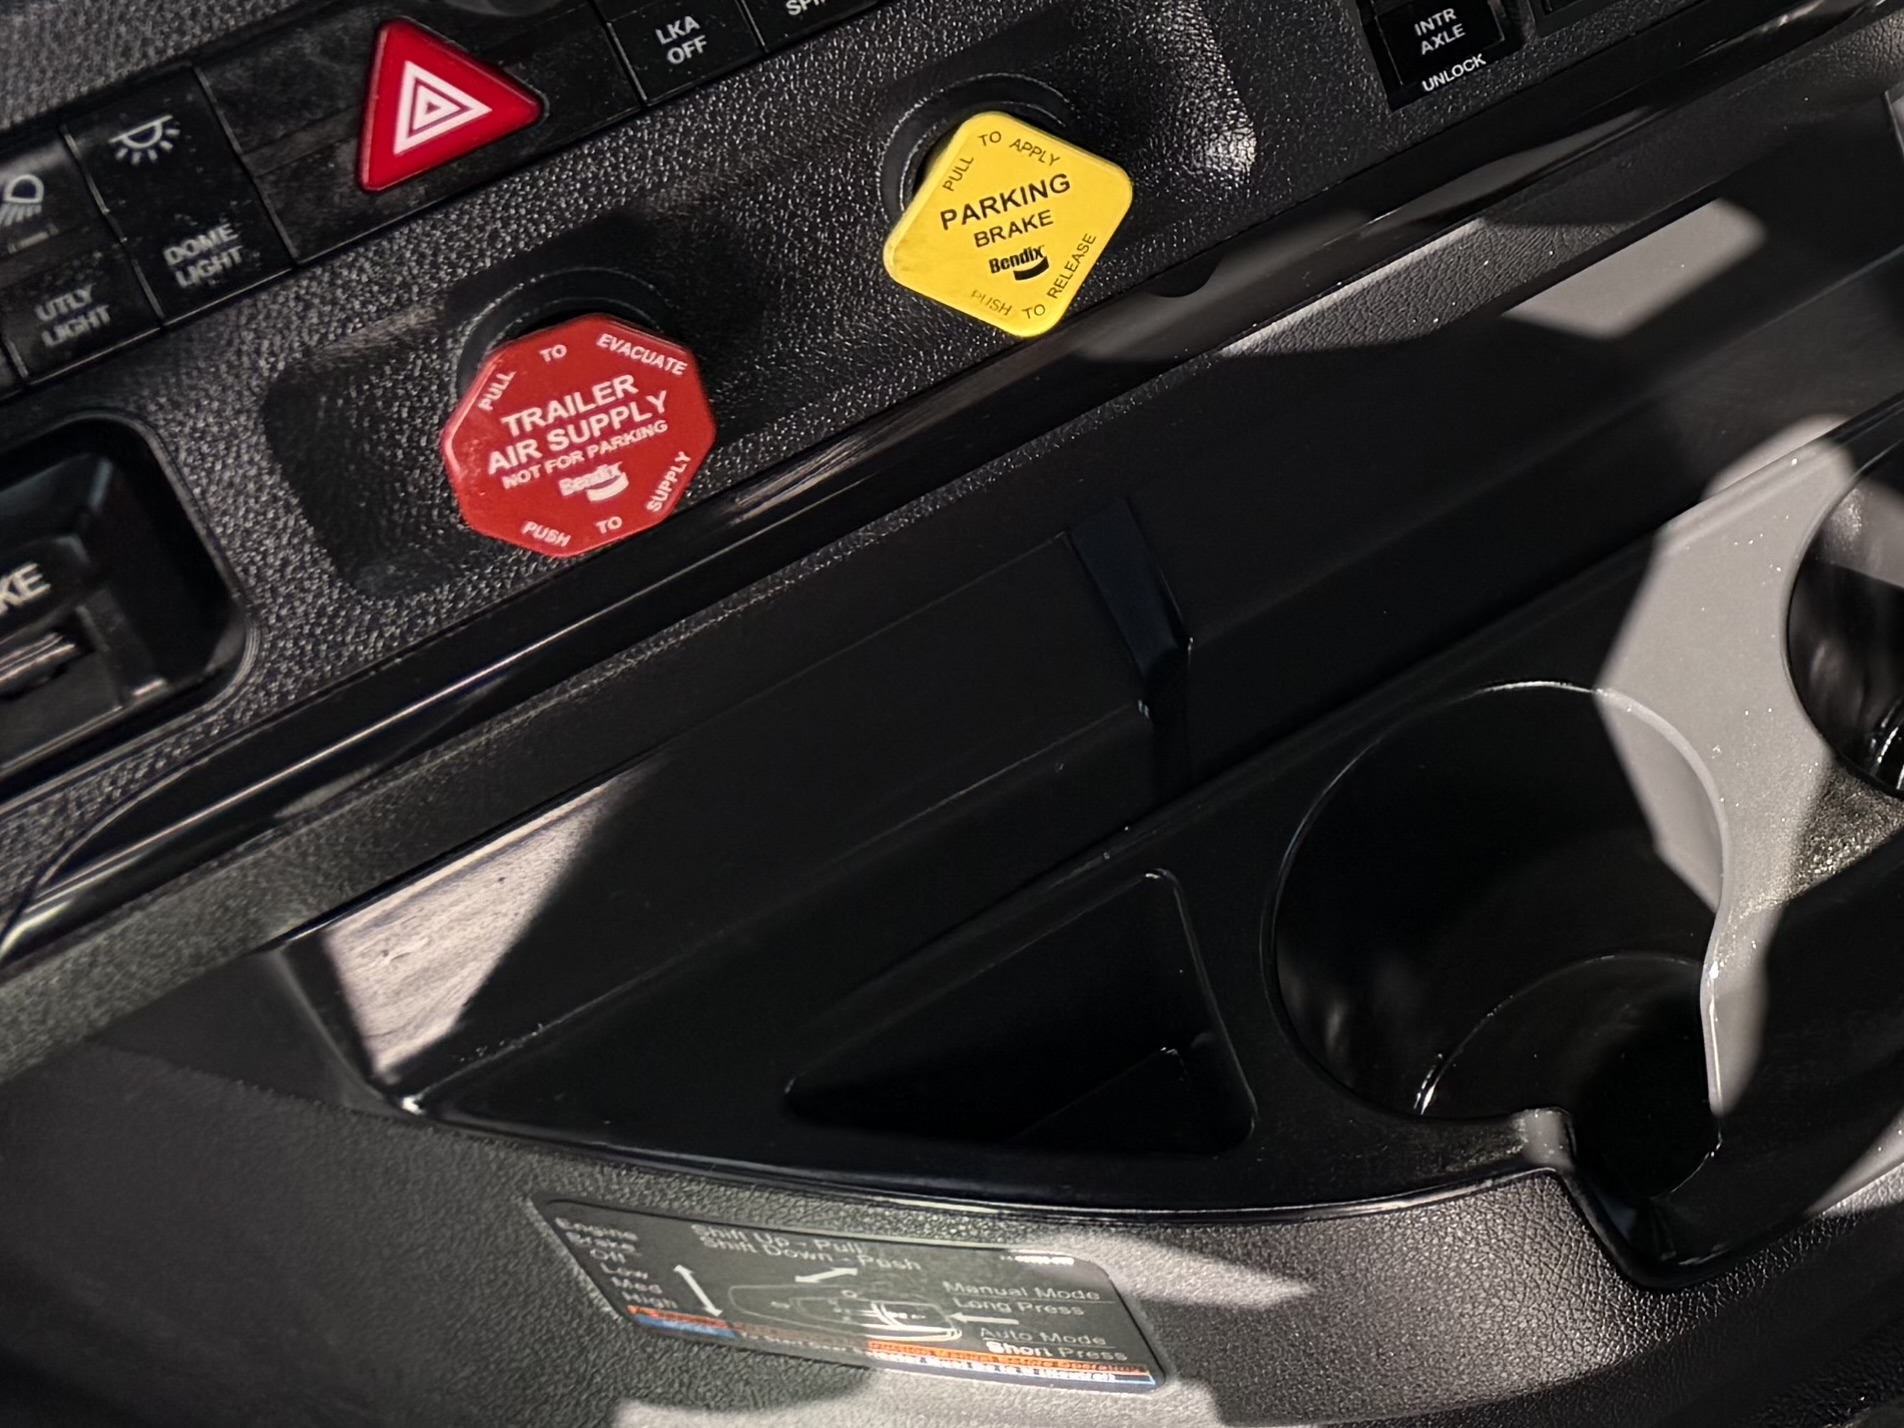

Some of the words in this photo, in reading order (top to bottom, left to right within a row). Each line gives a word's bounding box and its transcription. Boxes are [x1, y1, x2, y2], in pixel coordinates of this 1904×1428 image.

[655, 14, 701, 46] LKA
[1413, 7, 1457, 37] INTR
[1419, 22, 1466, 55] AXLE
[666, 34, 708, 66] OFF
[1421, 53, 1487, 92] UNLOCK
[942, 155, 974, 192] PULL
[978, 130, 1002, 147] TO
[1009, 137, 1061, 167] APPLY
[939, 173, 1071, 231] PARKING
[162, 223, 240, 266] DOME
[973, 209, 1054, 248] BRAKE
[174, 245, 243, 289] LIGHT
[970, 289, 1013, 317] PUSH
[1022, 303, 1046, 320] TO
[1046, 233, 1097, 300] RELEASE
[988, 245, 1045, 274] Bendix
[41, 304, 111, 347] LIGHT
[478, 369, 517, 412] PULL
[538, 344, 568, 364] TO
[596, 332, 688, 376] EVACUATE
[500, 374, 639, 437] TRAILER
[487, 438, 543, 475] AIR
[546, 389, 668, 452] SUPPLY
[502, 464, 541, 490] NOT
[544, 450, 585, 474] FOR
[586, 419, 669, 460] PARKING
[521, 520, 572, 548] PUSH
[595, 516, 623, 535] TO
[645, 451, 692, 513] SUPPLY
[764, 1245, 833, 1262] Down
[942, 1281, 1028, 1298] Manual
[1034, 1287, 1101, 1301] Mode
[952, 1297, 1013, 1314] Long
[1017, 1300, 1085, 1316] Press
[980, 1327, 1033, 1342] Auto
[1040, 1331, 1107, 1346] Mode
[985, 1340, 1055, 1358] Short
[1058, 1347, 1129, 1362] Press
